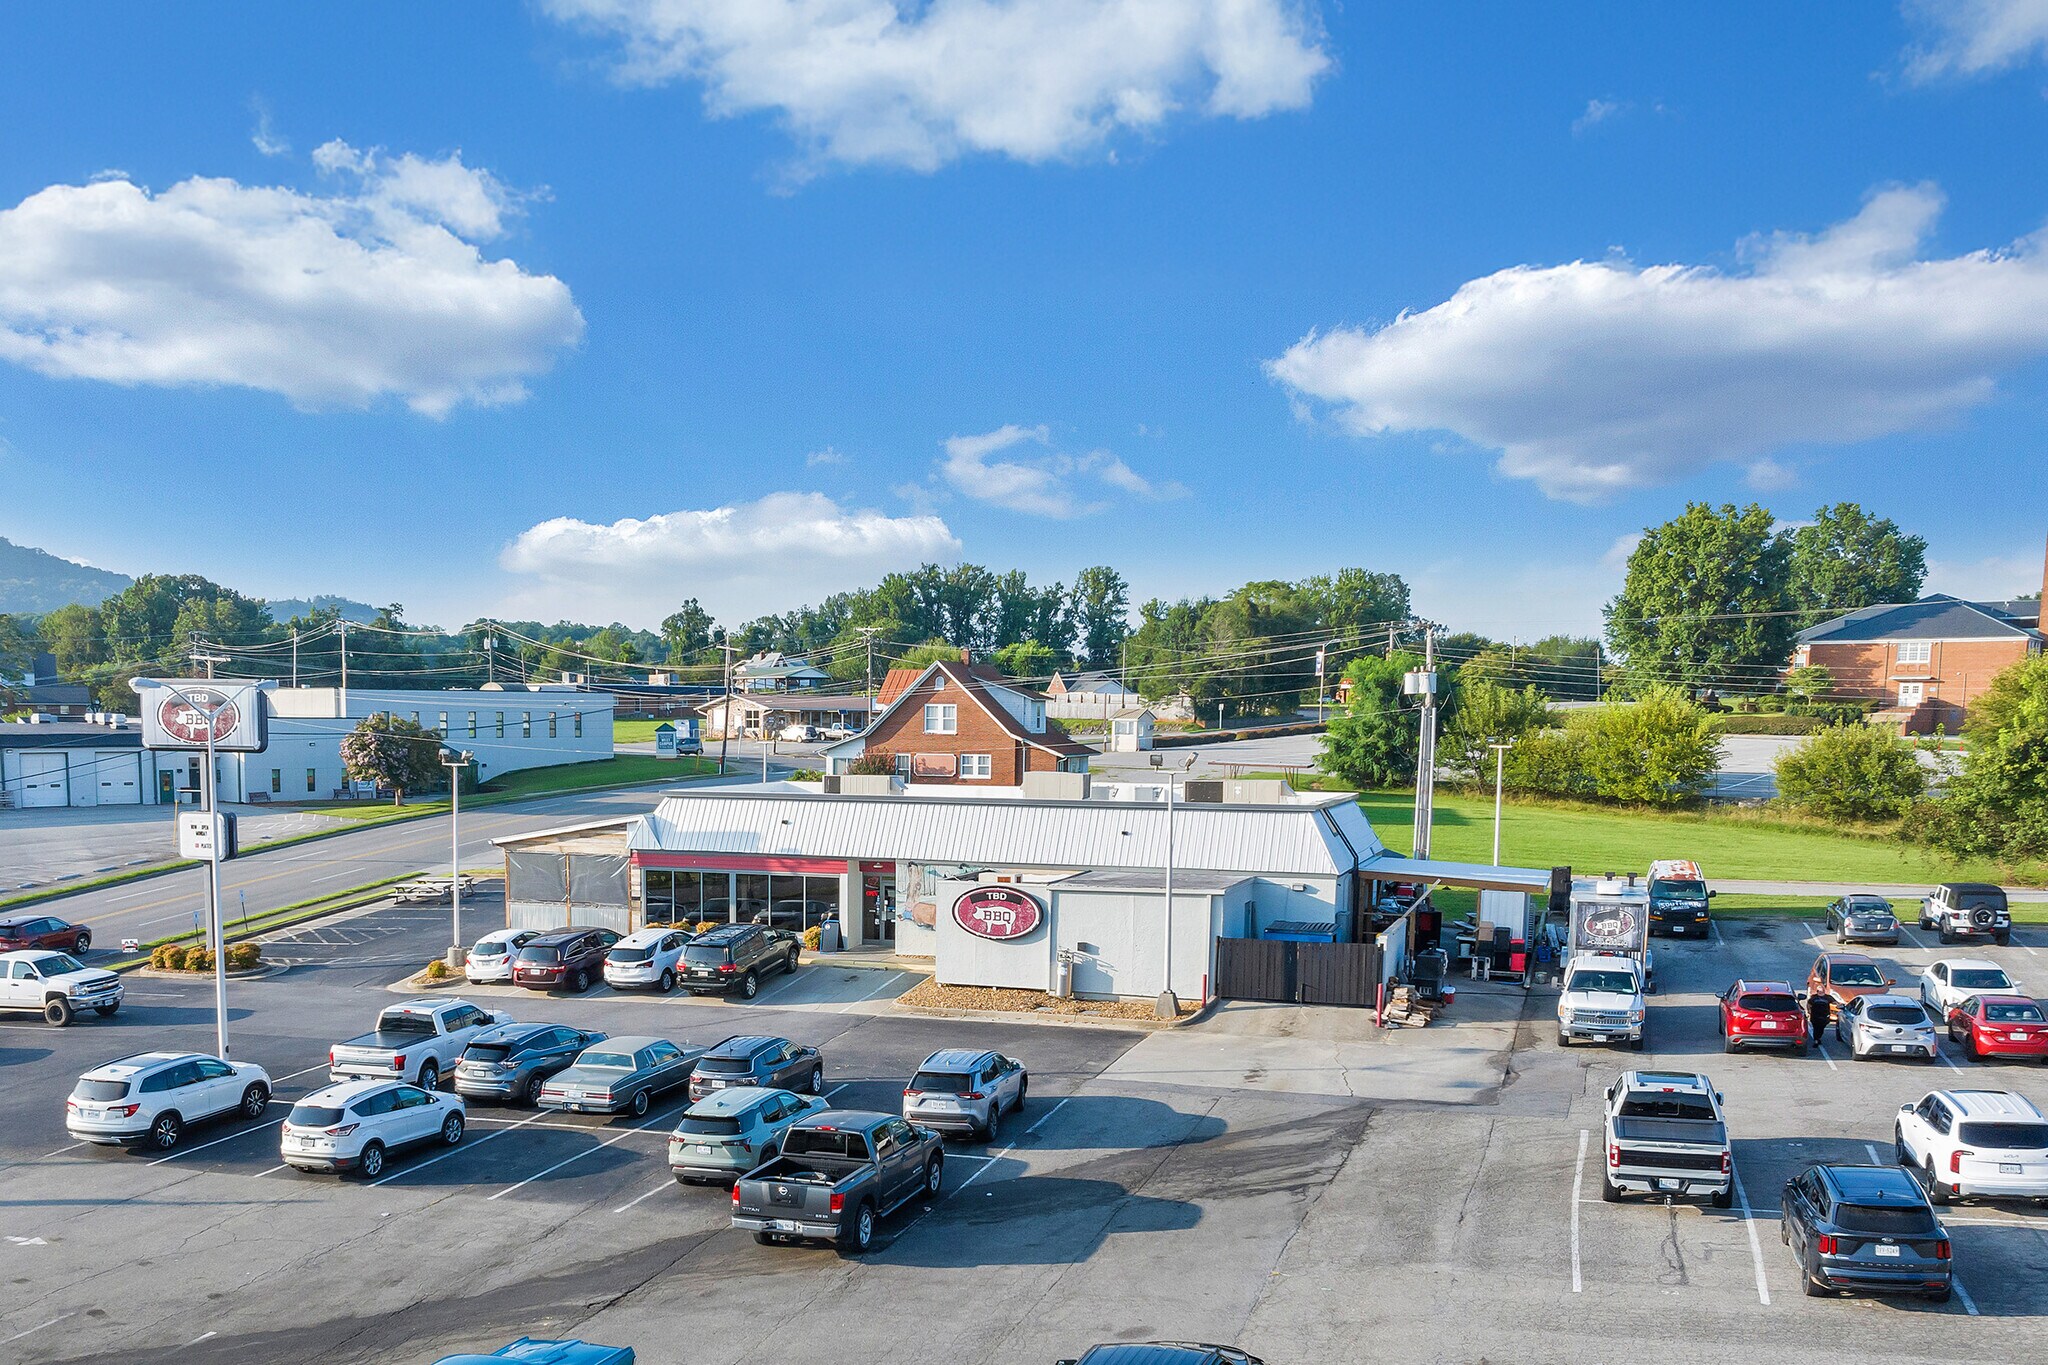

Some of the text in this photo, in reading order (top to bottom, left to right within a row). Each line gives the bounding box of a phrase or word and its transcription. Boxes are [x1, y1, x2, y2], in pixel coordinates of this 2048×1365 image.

[187, 693, 209, 703] TBD
[986, 892, 1008, 901] TBD
[983, 911, 1012, 922] BBQ
[1601, 922, 1619, 930] BBQ
